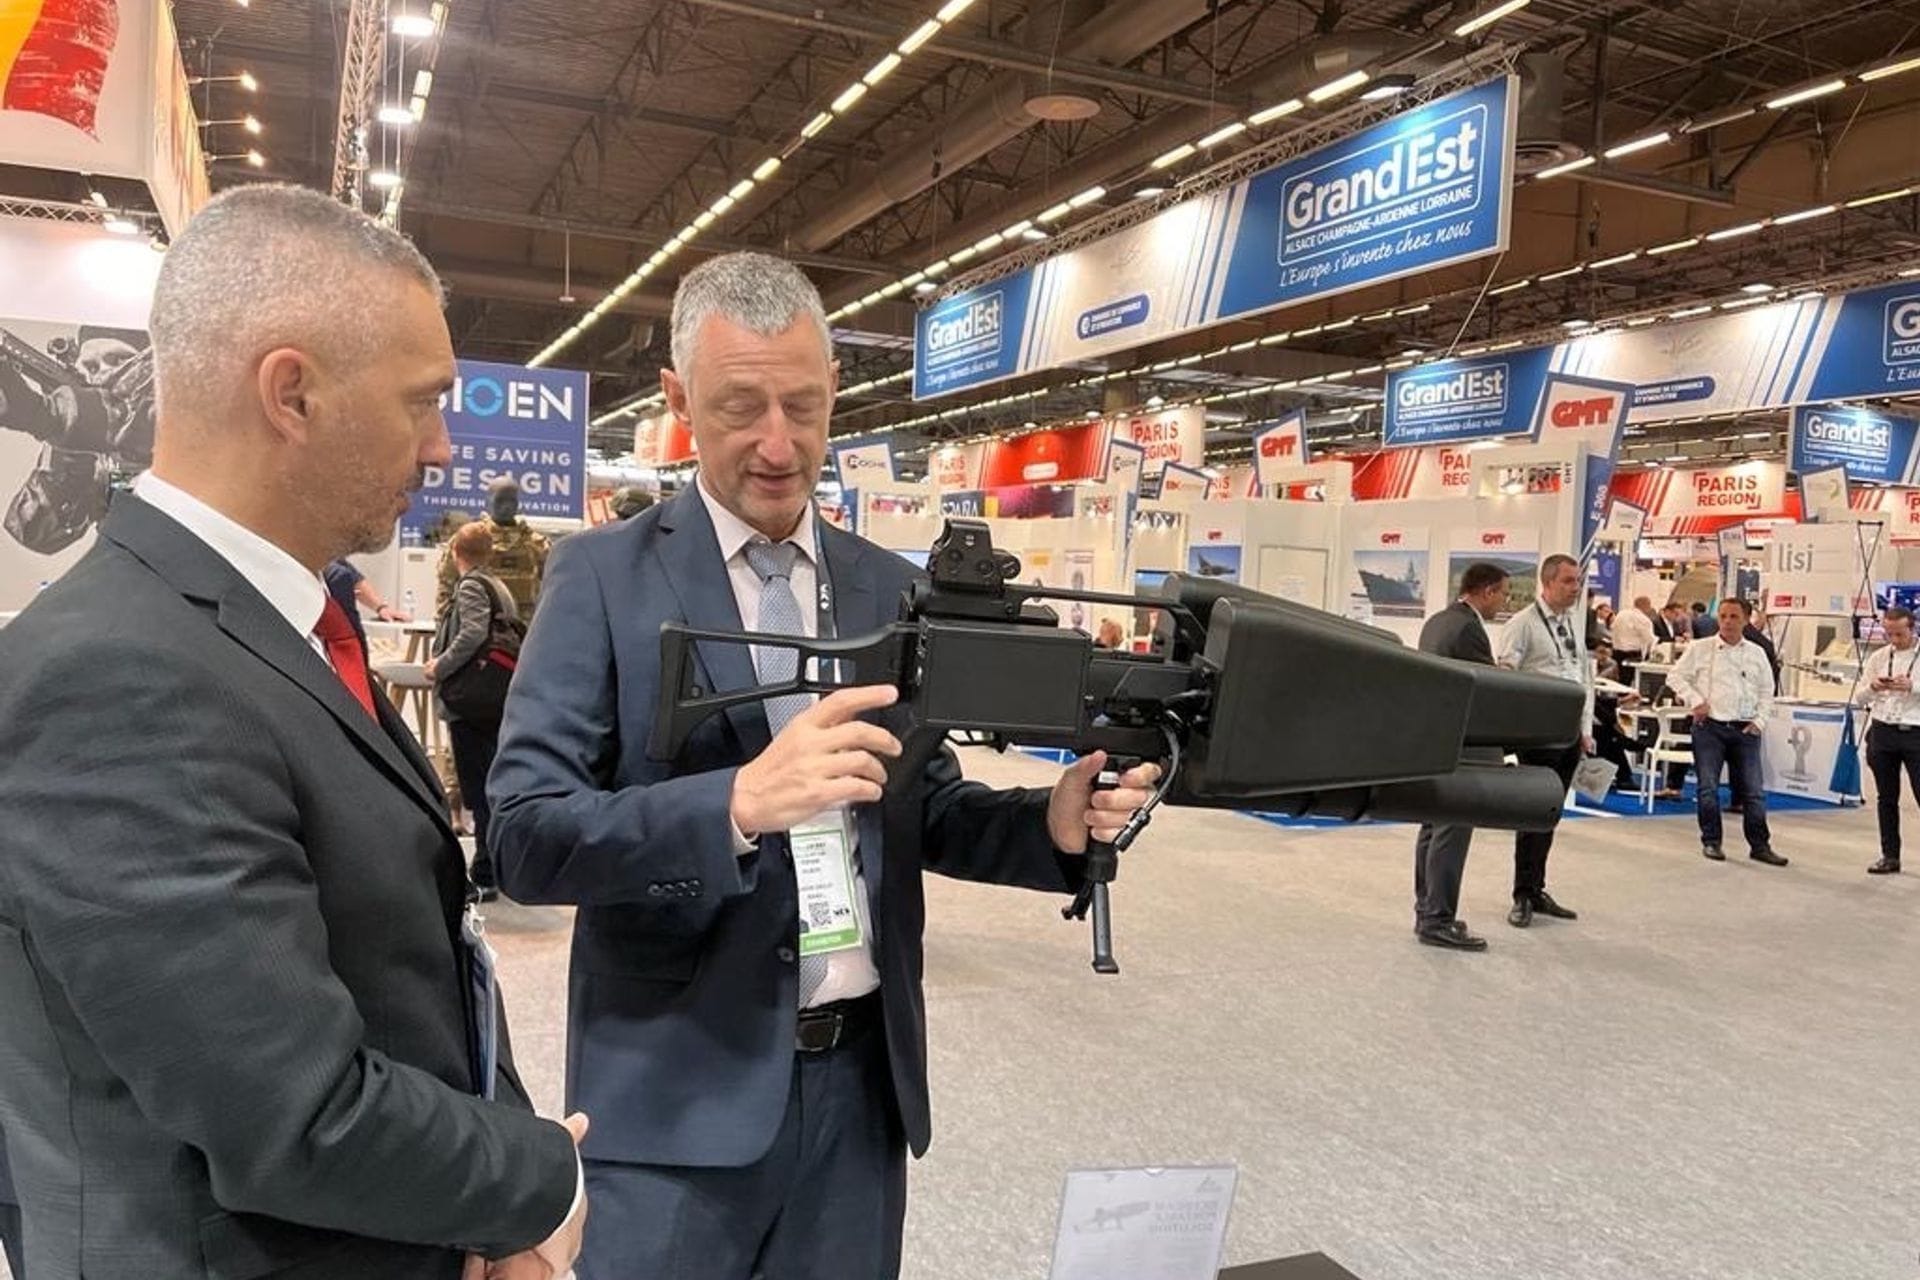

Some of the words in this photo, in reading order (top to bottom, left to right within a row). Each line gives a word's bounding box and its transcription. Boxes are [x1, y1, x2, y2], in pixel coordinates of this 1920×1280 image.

[1285, 236, 1316, 256] ALSACE
[1421, 184, 1473, 213] LORRAINE
[1395, 231, 1433, 255] chez
[1435, 220, 1474, 243] nous
[439, 376, 573, 422] IOEN
[1135, 421, 1179, 443] PARIS
[486, 448, 572, 466] SAVING
[1143, 444, 1177, 460] EGION
[1698, 474, 1757, 493] PARIS
[423, 495, 486, 508] THROUGH
[1697, 491, 1756, 507] REGION
